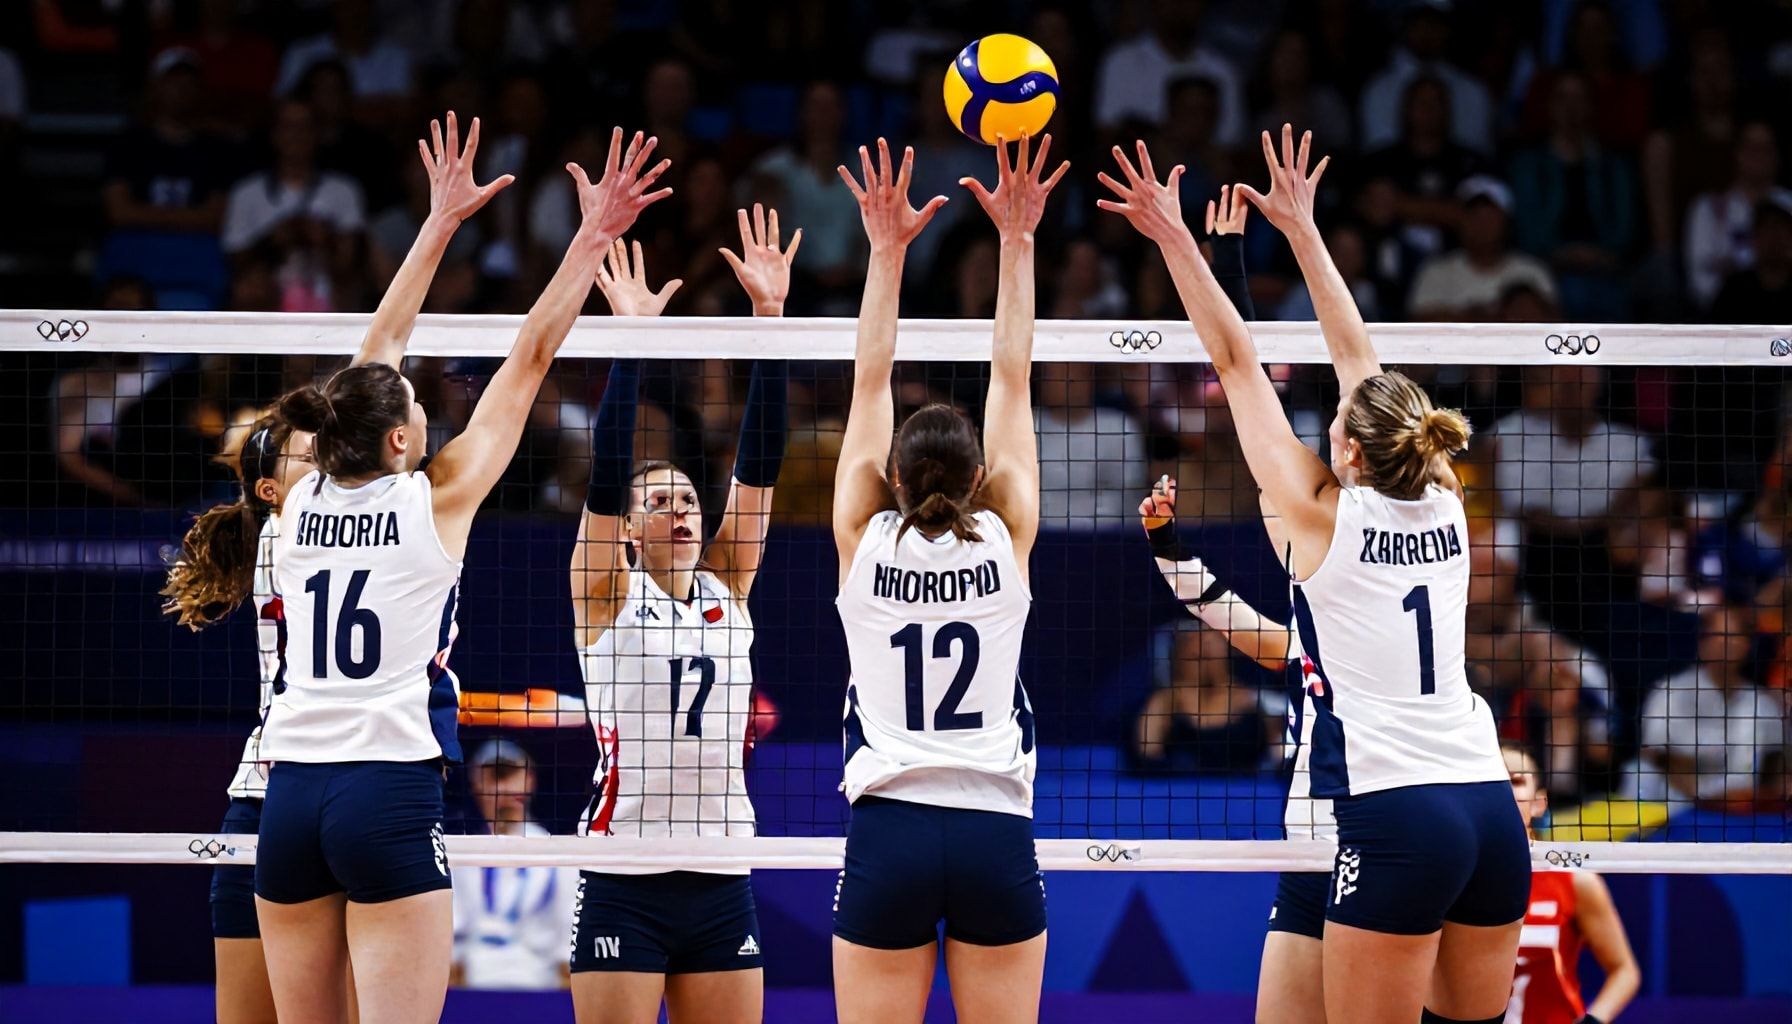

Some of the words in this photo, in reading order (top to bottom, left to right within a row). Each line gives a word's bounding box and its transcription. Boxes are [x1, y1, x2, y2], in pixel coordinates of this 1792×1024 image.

[305, 569, 381, 680] 16
[890, 621, 983, 731] 12
[1402, 585, 1436, 696] 1
